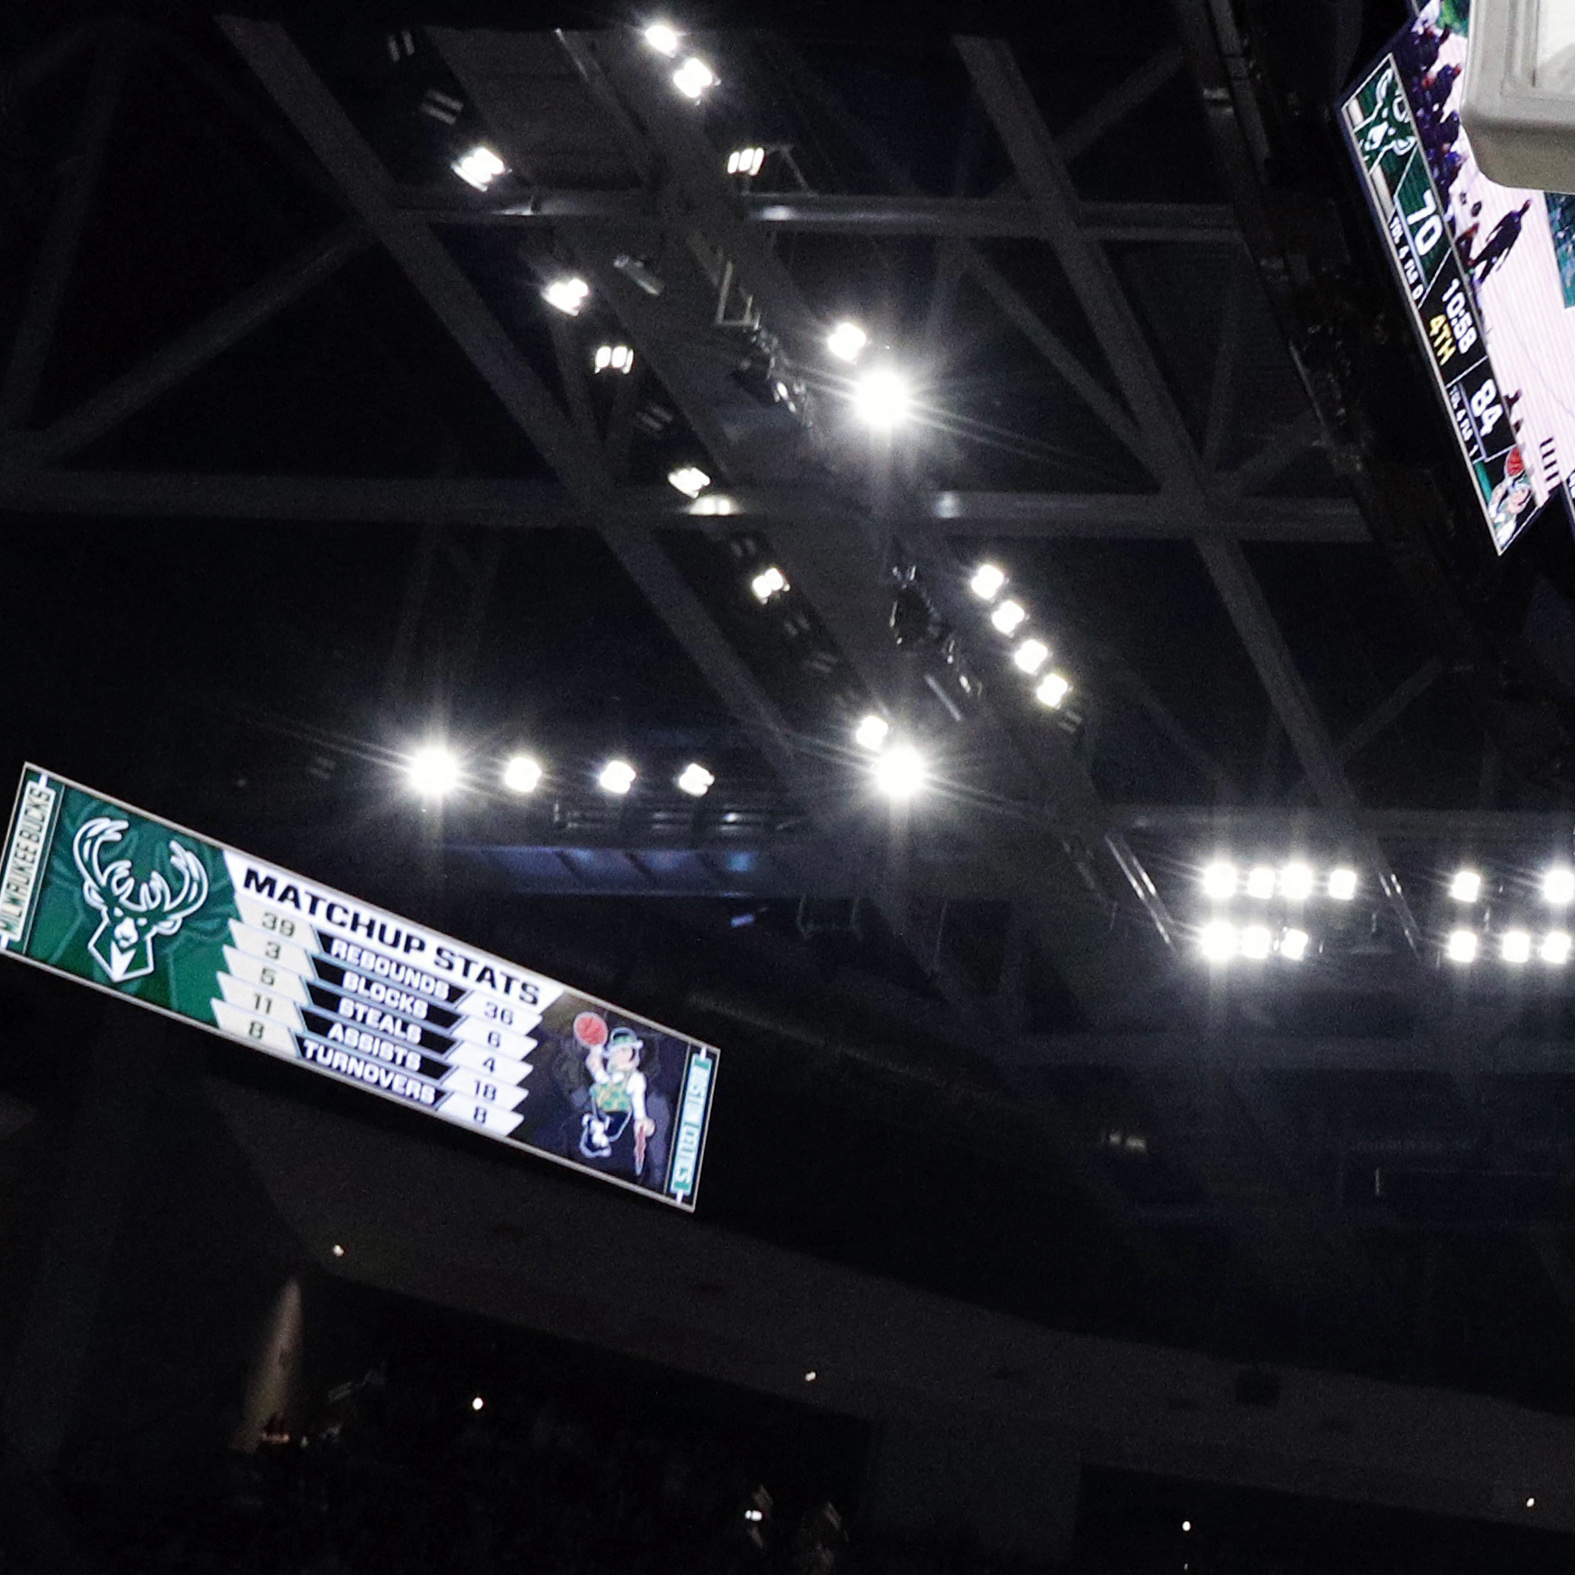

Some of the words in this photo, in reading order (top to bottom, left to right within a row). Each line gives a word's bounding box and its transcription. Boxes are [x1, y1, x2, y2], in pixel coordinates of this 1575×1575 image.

[1408, 189, 1442, 256] 70
[1430, 314, 1456, 365] 4TH
[1442, 279, 1477, 354] 10:58
[1472, 379, 1503, 436] 84
[19, 787, 49, 843] BUCKS
[243, 868, 426, 954] MATCHUP
[434, 947, 540, 1005] STATS
[262, 912, 295, 937] 39
[330, 939, 450, 1000] REBOUNDS
[484, 1002, 513, 1026] 36
[261, 967, 275, 986] 5
[338, 997, 422, 1045] STEALS
[483, 1056, 496, 1072] 4
[265, 941, 280, 960] 3
[342, 971, 428, 1019] BLOCKS
[488, 1029, 501, 1047] 6
[250, 1021, 265, 1040] 8
[303, 1040, 435, 1105] TURNOVERS
[473, 1105, 487, 1124] 8
[252, 993, 272, 1013] 11
[327, 1022, 421, 1071] ASSISTS
[473, 1079, 497, 1100] 18
